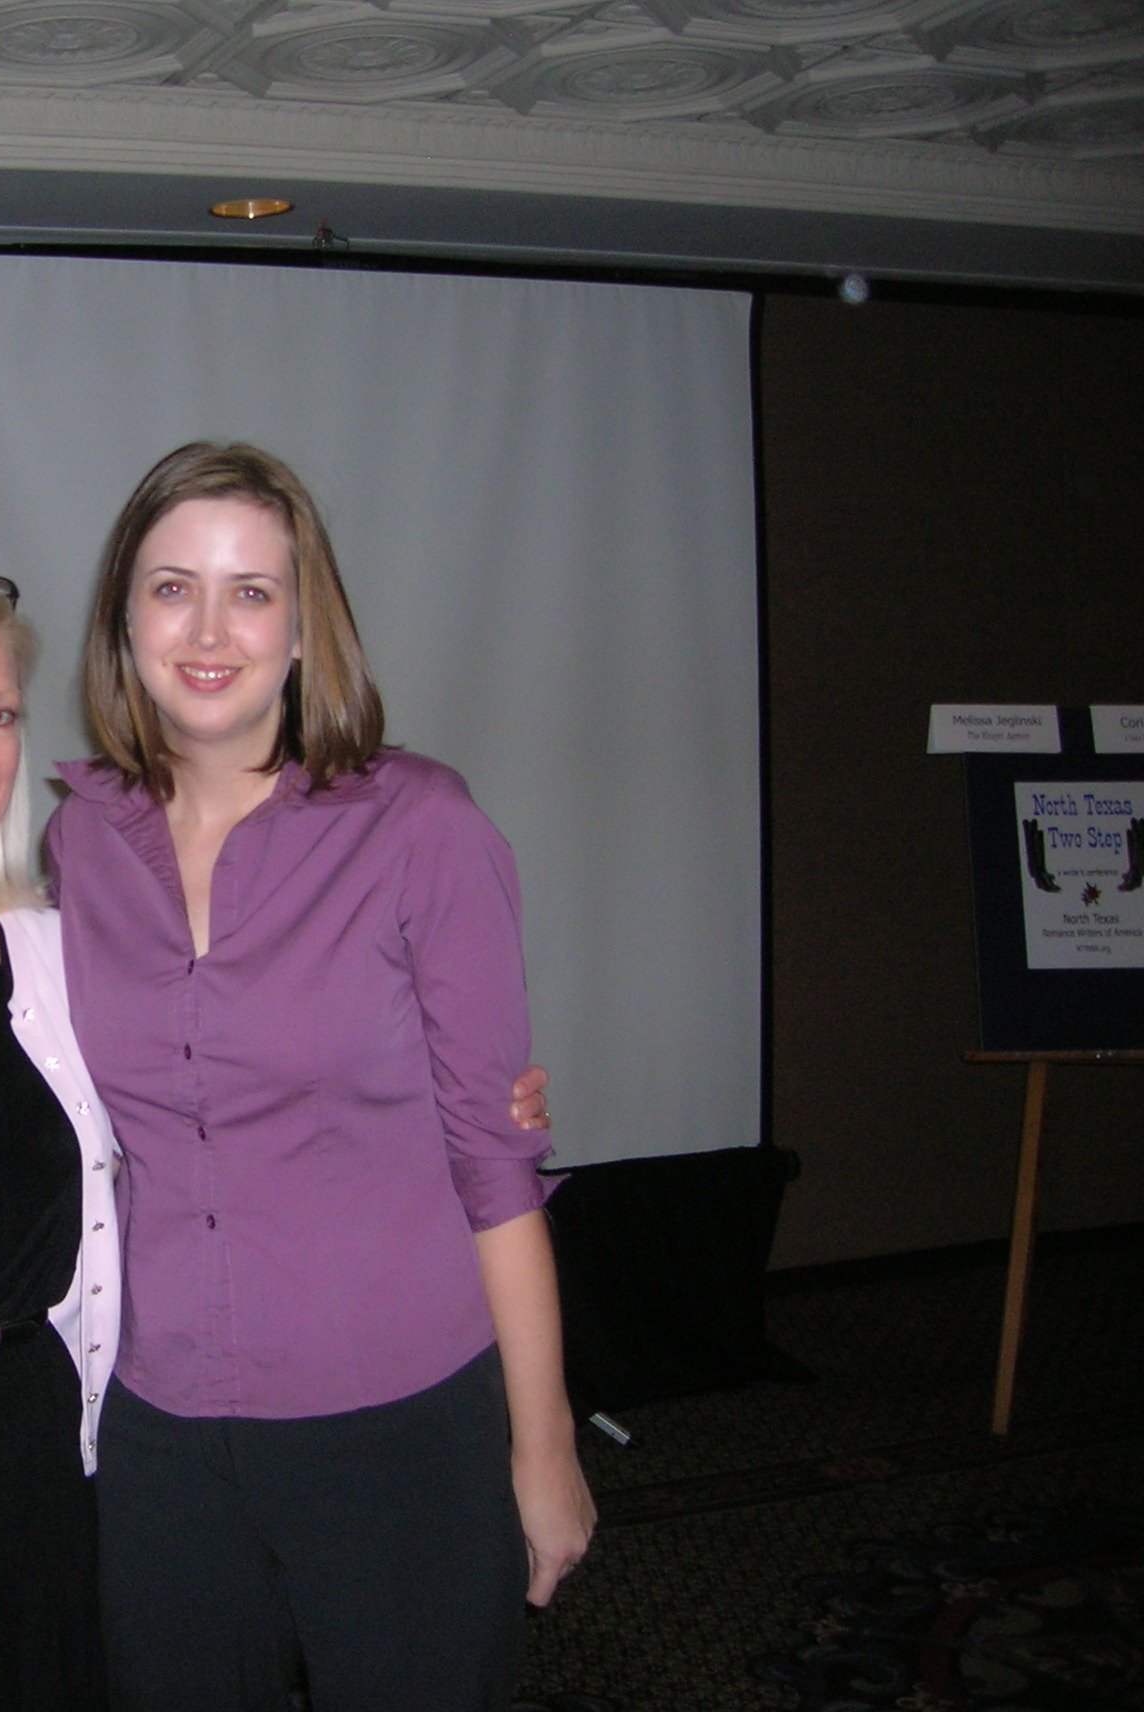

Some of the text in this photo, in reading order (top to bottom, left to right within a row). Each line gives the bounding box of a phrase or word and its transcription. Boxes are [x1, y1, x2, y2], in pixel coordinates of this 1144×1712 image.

[1032, 794, 1133, 816] North Texas
[1047, 826, 1122, 855] Two Step
[1063, 913, 1120, 924] North Texas
